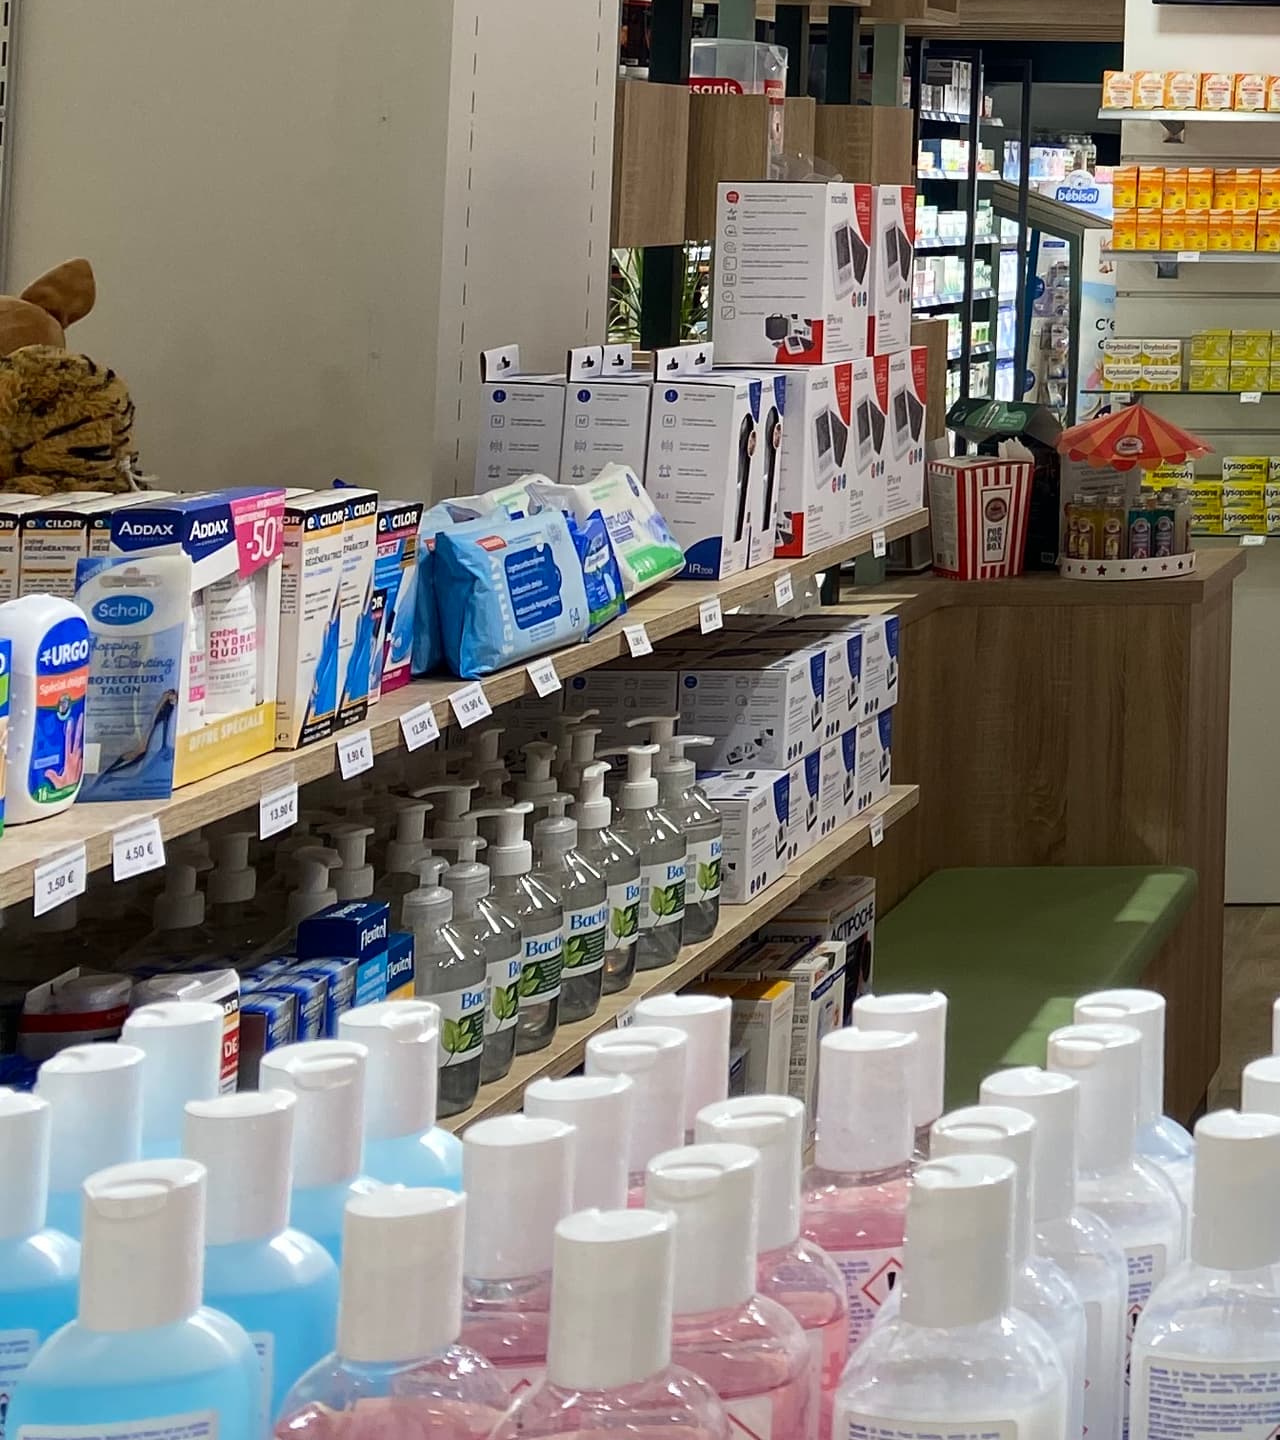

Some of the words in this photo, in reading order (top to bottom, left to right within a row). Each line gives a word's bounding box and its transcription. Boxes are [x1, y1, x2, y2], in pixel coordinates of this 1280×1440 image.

[1057, 190, 1098, 203] bébisol
[118, 520, 174, 537] ADDAX
[189, 518, 229, 542] ADDAX
[98, 601, 148, 619] Scholl
[51, 639, 89, 667] URGO
[100, 685, 141, 695] TALON
[287, 800, 294, 812] €
[125, 845, 145, 861] 4.50
[147, 841, 154, 855] €
[47, 874, 66, 895] 3.50
[68, 869, 74, 883] €
[831, 901, 874, 942] ACTIPOCHE
